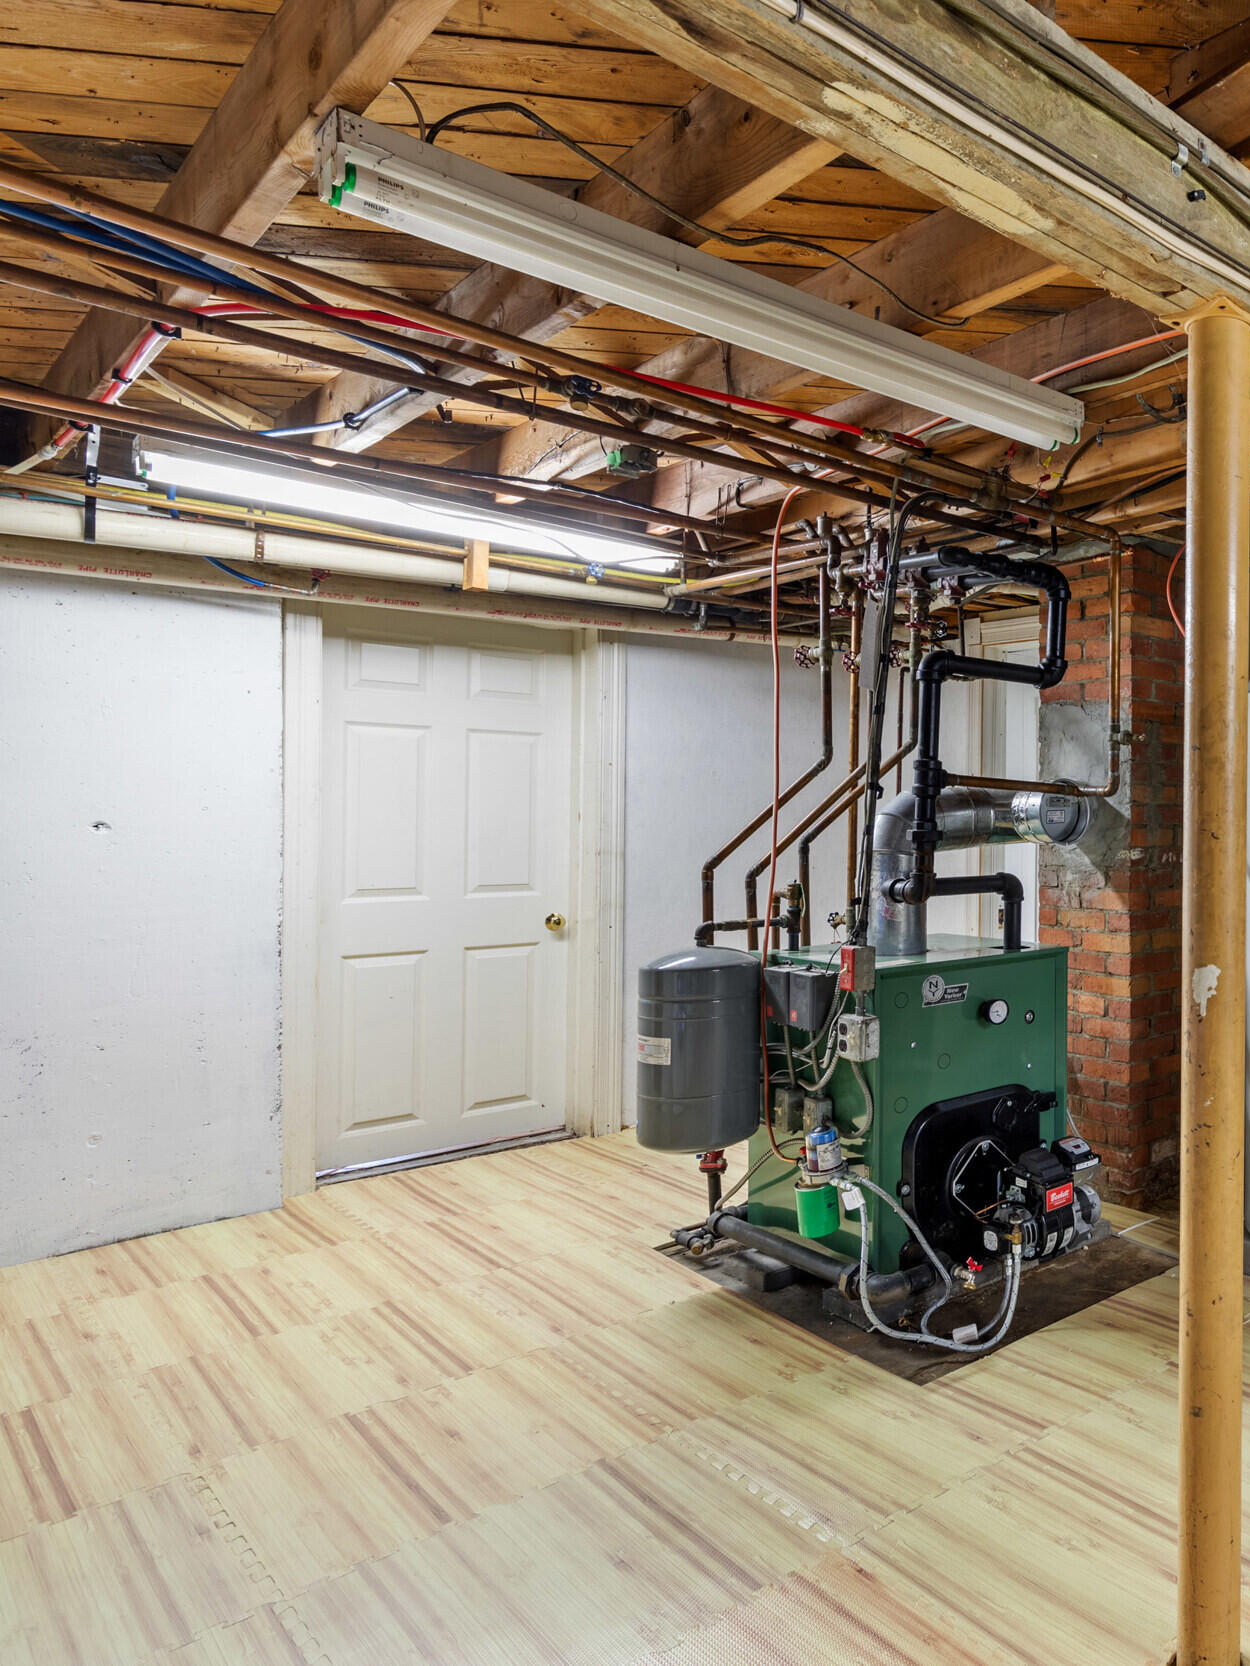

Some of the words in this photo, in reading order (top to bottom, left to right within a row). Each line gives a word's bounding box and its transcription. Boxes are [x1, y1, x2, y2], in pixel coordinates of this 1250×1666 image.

[378, 176, 404, 190] PHILIPS
[363, 200, 390, 214] PHILIPS
[77, 563, 97, 573] PIPE
[103, 567, 152, 579] CHARLOTTE
